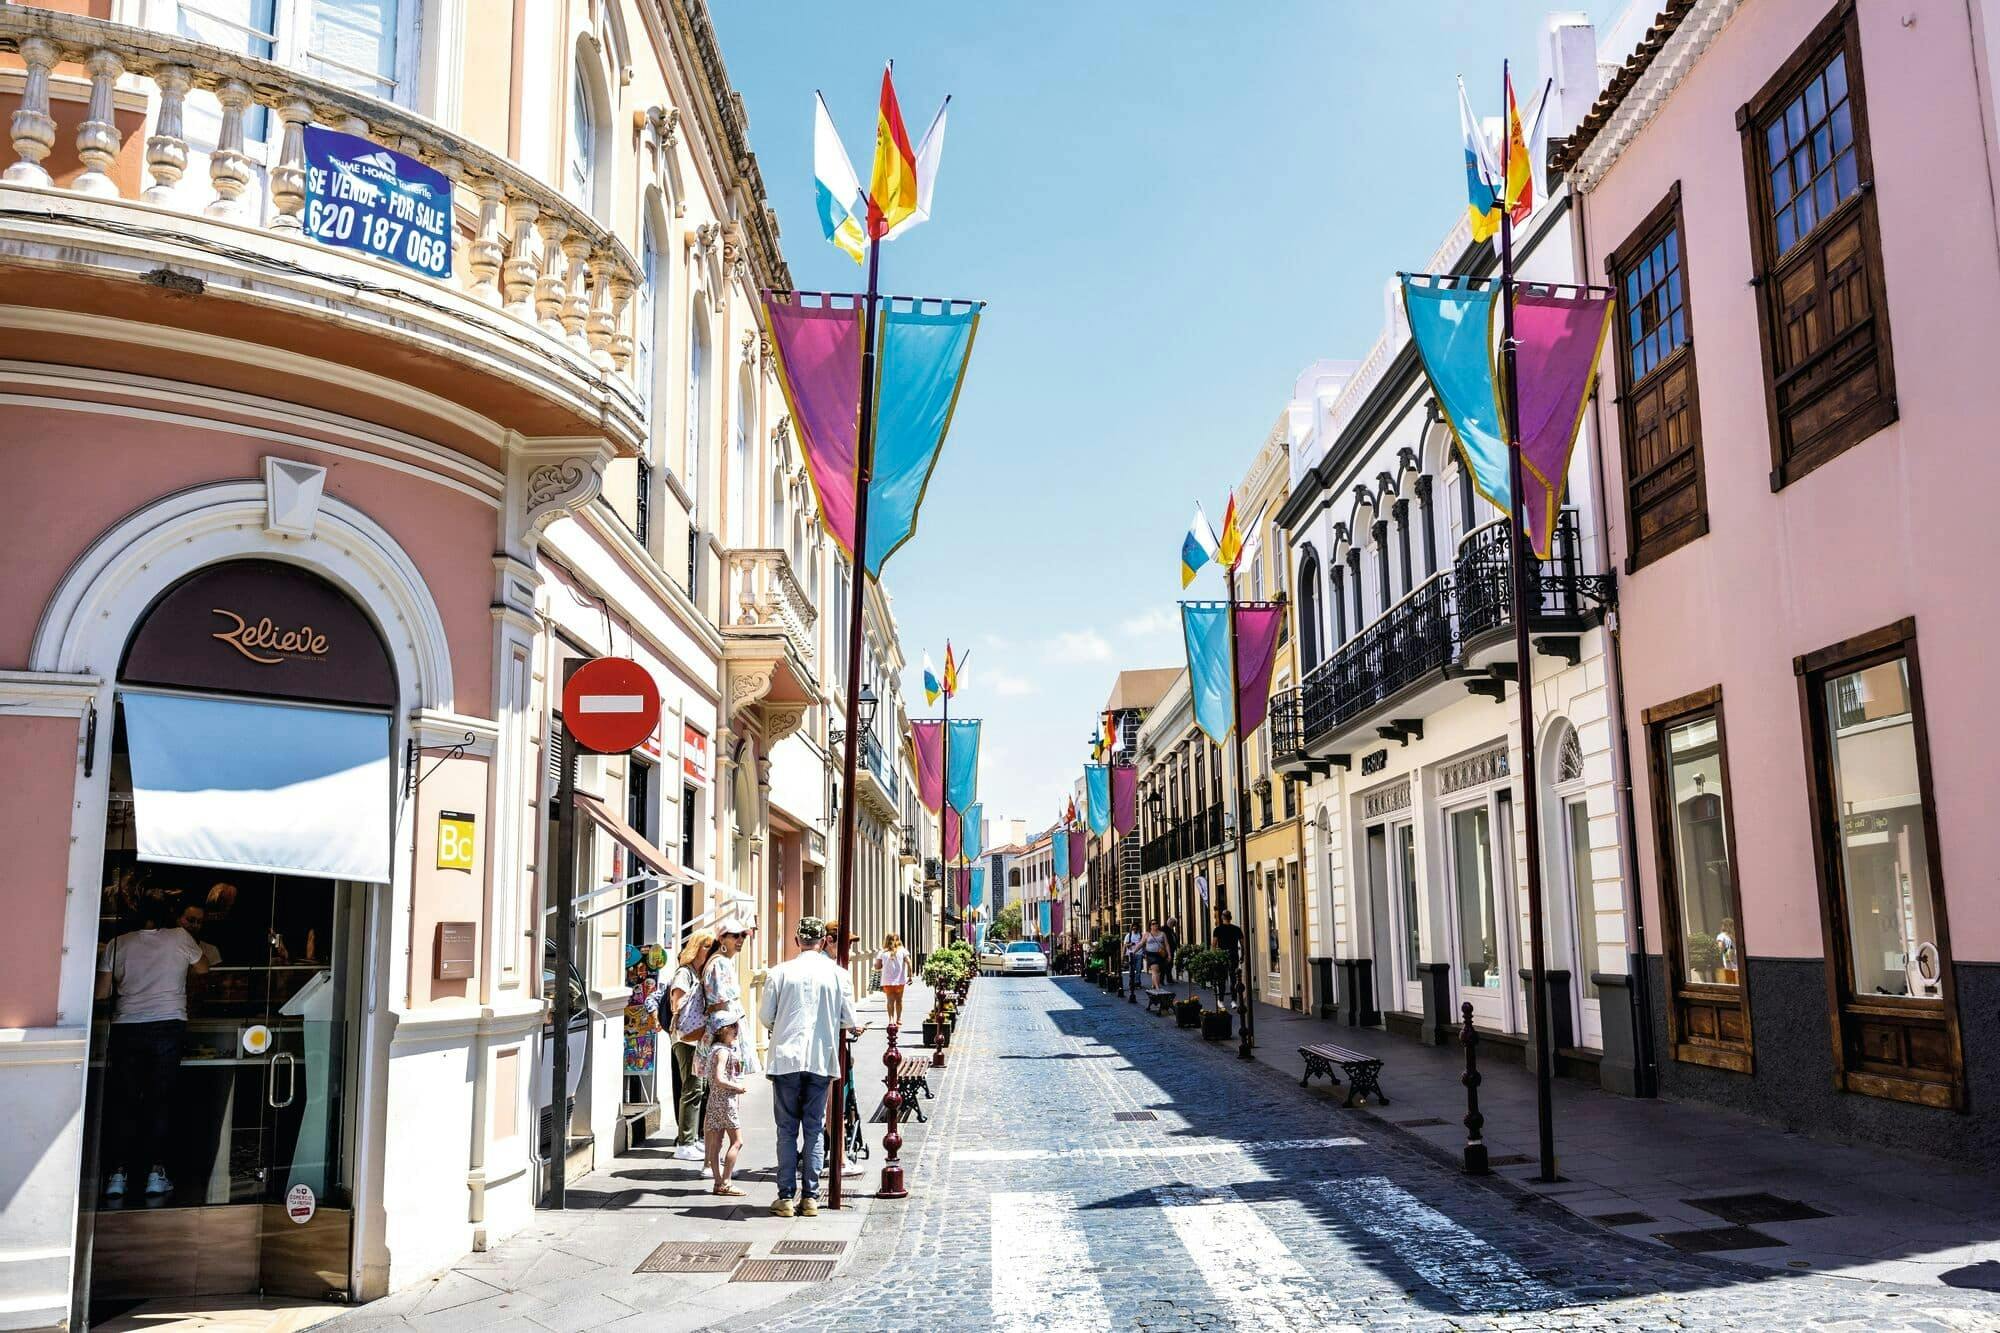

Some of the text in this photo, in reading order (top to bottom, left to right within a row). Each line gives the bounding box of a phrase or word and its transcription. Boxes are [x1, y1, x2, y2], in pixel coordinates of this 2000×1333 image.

[308, 166, 328, 196] SE
[330, 171, 377, 209] VENDE
[388, 190, 415, 222] FOR
[415, 202, 445, 236] SALE
[362, 164, 399, 187] HOMES
[309, 199, 447, 272] 620 187 068
[212, 608, 329, 664] Relieve
[440, 824, 472, 862] Bc
